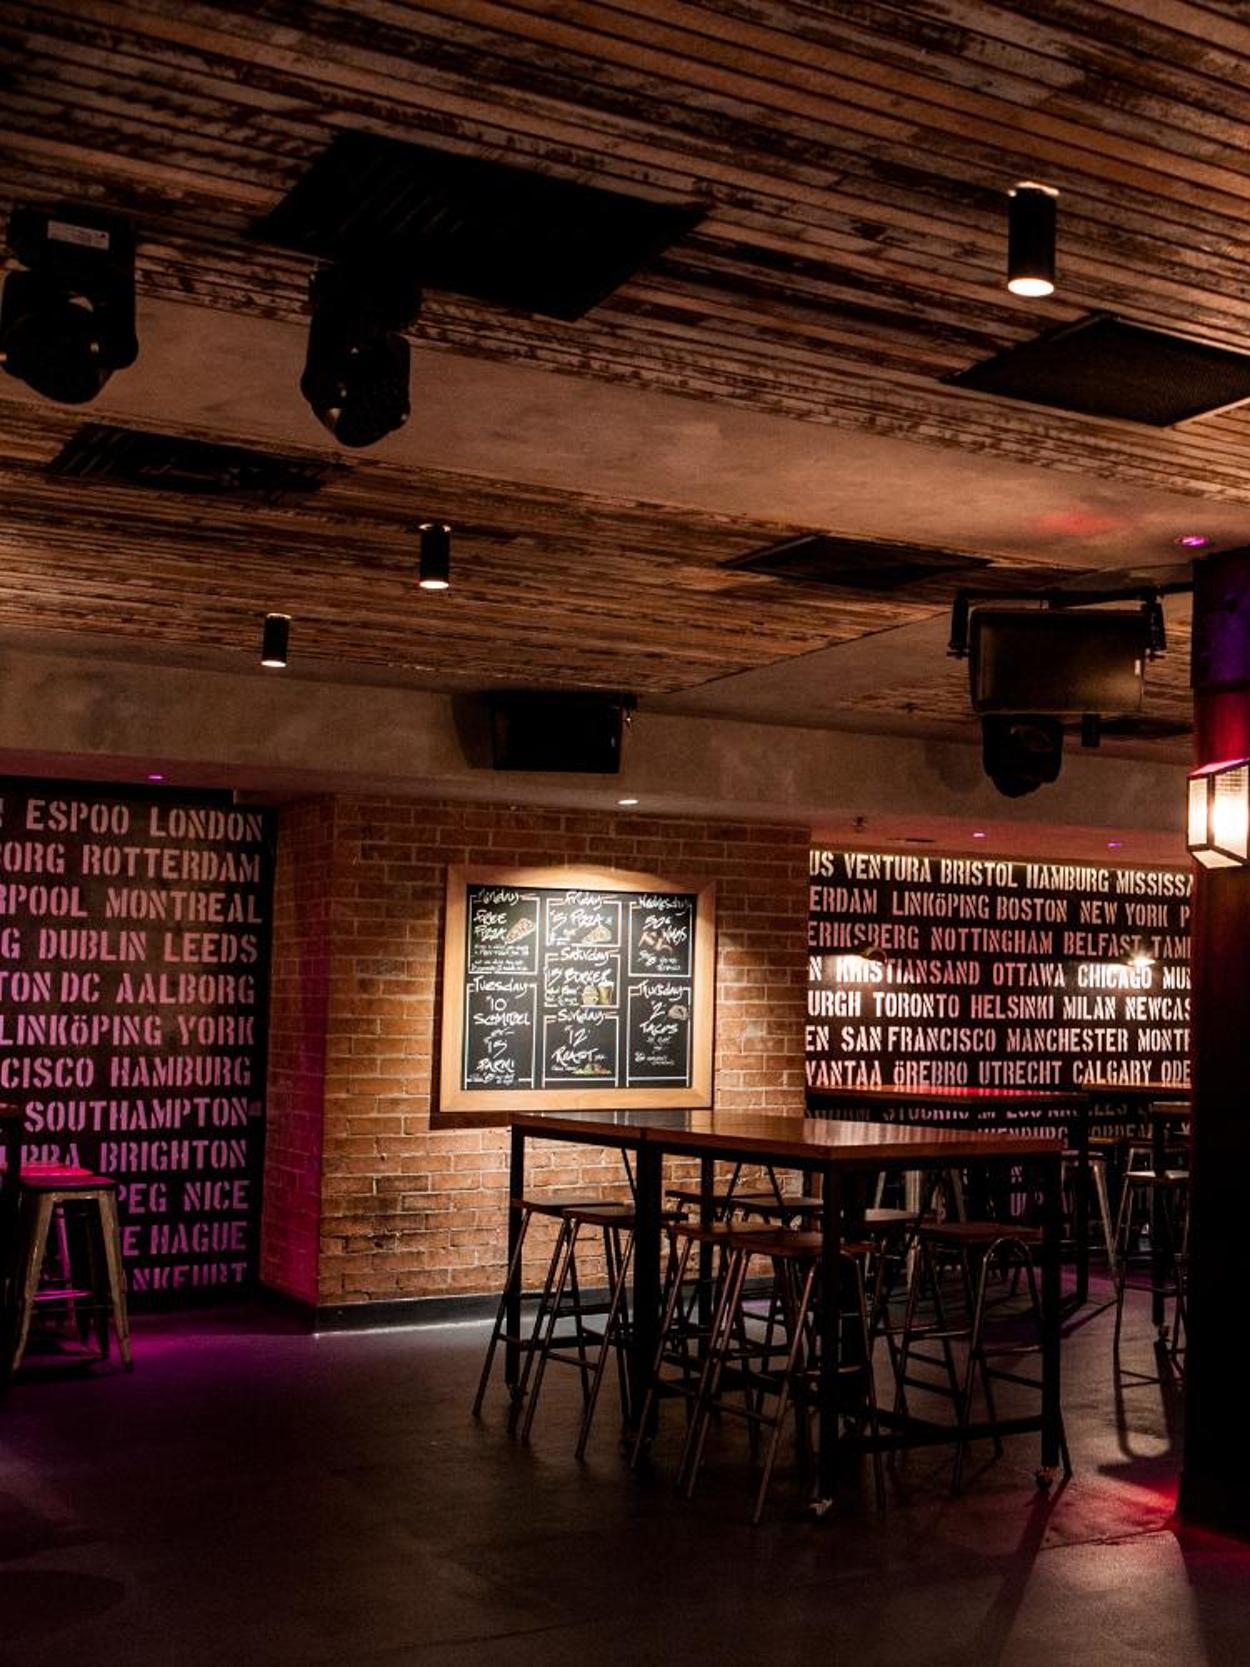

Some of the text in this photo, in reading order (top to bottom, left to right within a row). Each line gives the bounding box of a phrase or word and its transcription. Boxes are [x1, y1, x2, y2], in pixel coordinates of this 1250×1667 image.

[26, 798, 129, 835] ESPOO
[150, 806, 262, 842] LONDON
[0, 841, 260, 882] ORG ROTTERDAM
[844, 851, 931, 883] VENTURA
[941, 858, 1018, 889] BRISTOL
[1026, 863, 1109, 893] HAMBURG
[106, 887, 262, 923] MONTREAL
[809, 885, 877, 914] ERDAM
[997, 896, 1067, 923] BOSTON
[1080, 901, 1117, 925] NEW
[1125, 903, 1168, 927] YORK
[38, 928, 147, 961] DUBLIN
[164, 932, 258, 963] LEEDS
[931, 926, 1052, 954] NOTTINGHAM
[1064, 931, 1142, 957] BELFAST
[61, 971, 101, 1003] DC
[116, 972, 255, 1004] AALBORG
[473, 975, 527, 999] Tuesday
[808, 955, 822, 982] N
[993, 961, 1065, 987] OTTAWA
[1077, 963, 1153, 989] CHICAGO
[808, 990, 861, 1017] URGH
[873, 992, 959, 1018] TORONTO
[971, 994, 1054, 1020] HELSINKI
[1063, 996, 1116, 1021] MILAN
[178, 1014, 254, 1046] YORK
[805, 1024, 829, 1052] EN
[841, 1025, 881, 1052] SAN
[888, 1026, 996, 1052] FRANCISCO
[1007, 1027, 1128, 1053] MANCHESTER
[1, 1056, 250, 1089] CISCO HAMBURG
[805, 1060, 882, 1089] VANTAA
[979, 1061, 1062, 1086] UTRECHT
[1073, 1060, 1152, 1086] CALGARY
[24, 1098, 248, 1133] SOUTHAMPTON
[100, 1139, 246, 1173] BRIGHTON
[184, 1180, 249, 1212] NICE
[150, 1221, 247, 1255] HAGUE
